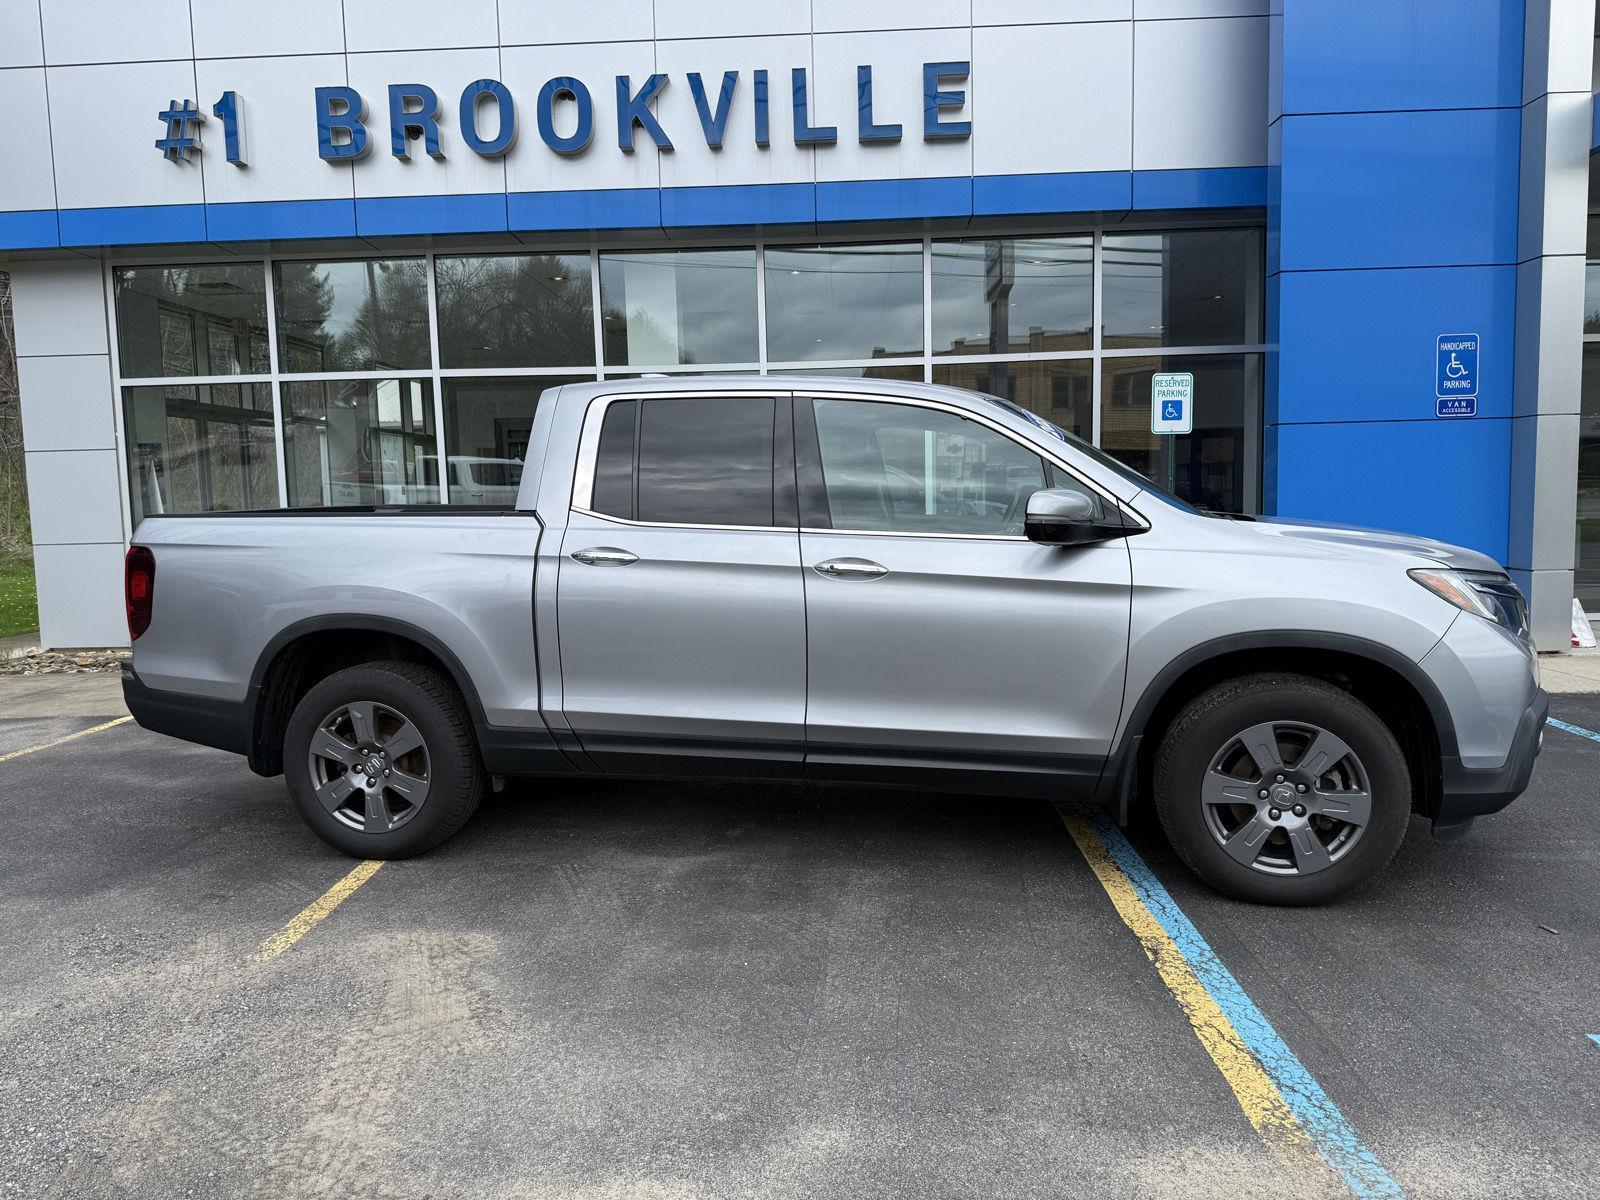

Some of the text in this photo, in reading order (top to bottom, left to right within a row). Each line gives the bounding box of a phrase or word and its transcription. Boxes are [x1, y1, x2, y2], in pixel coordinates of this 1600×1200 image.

[155, 61, 971, 167] #1 BROOKVILLE
[1440, 342, 1476, 350] HANDICAPPED
[1444, 380, 1470, 388] PARKING
